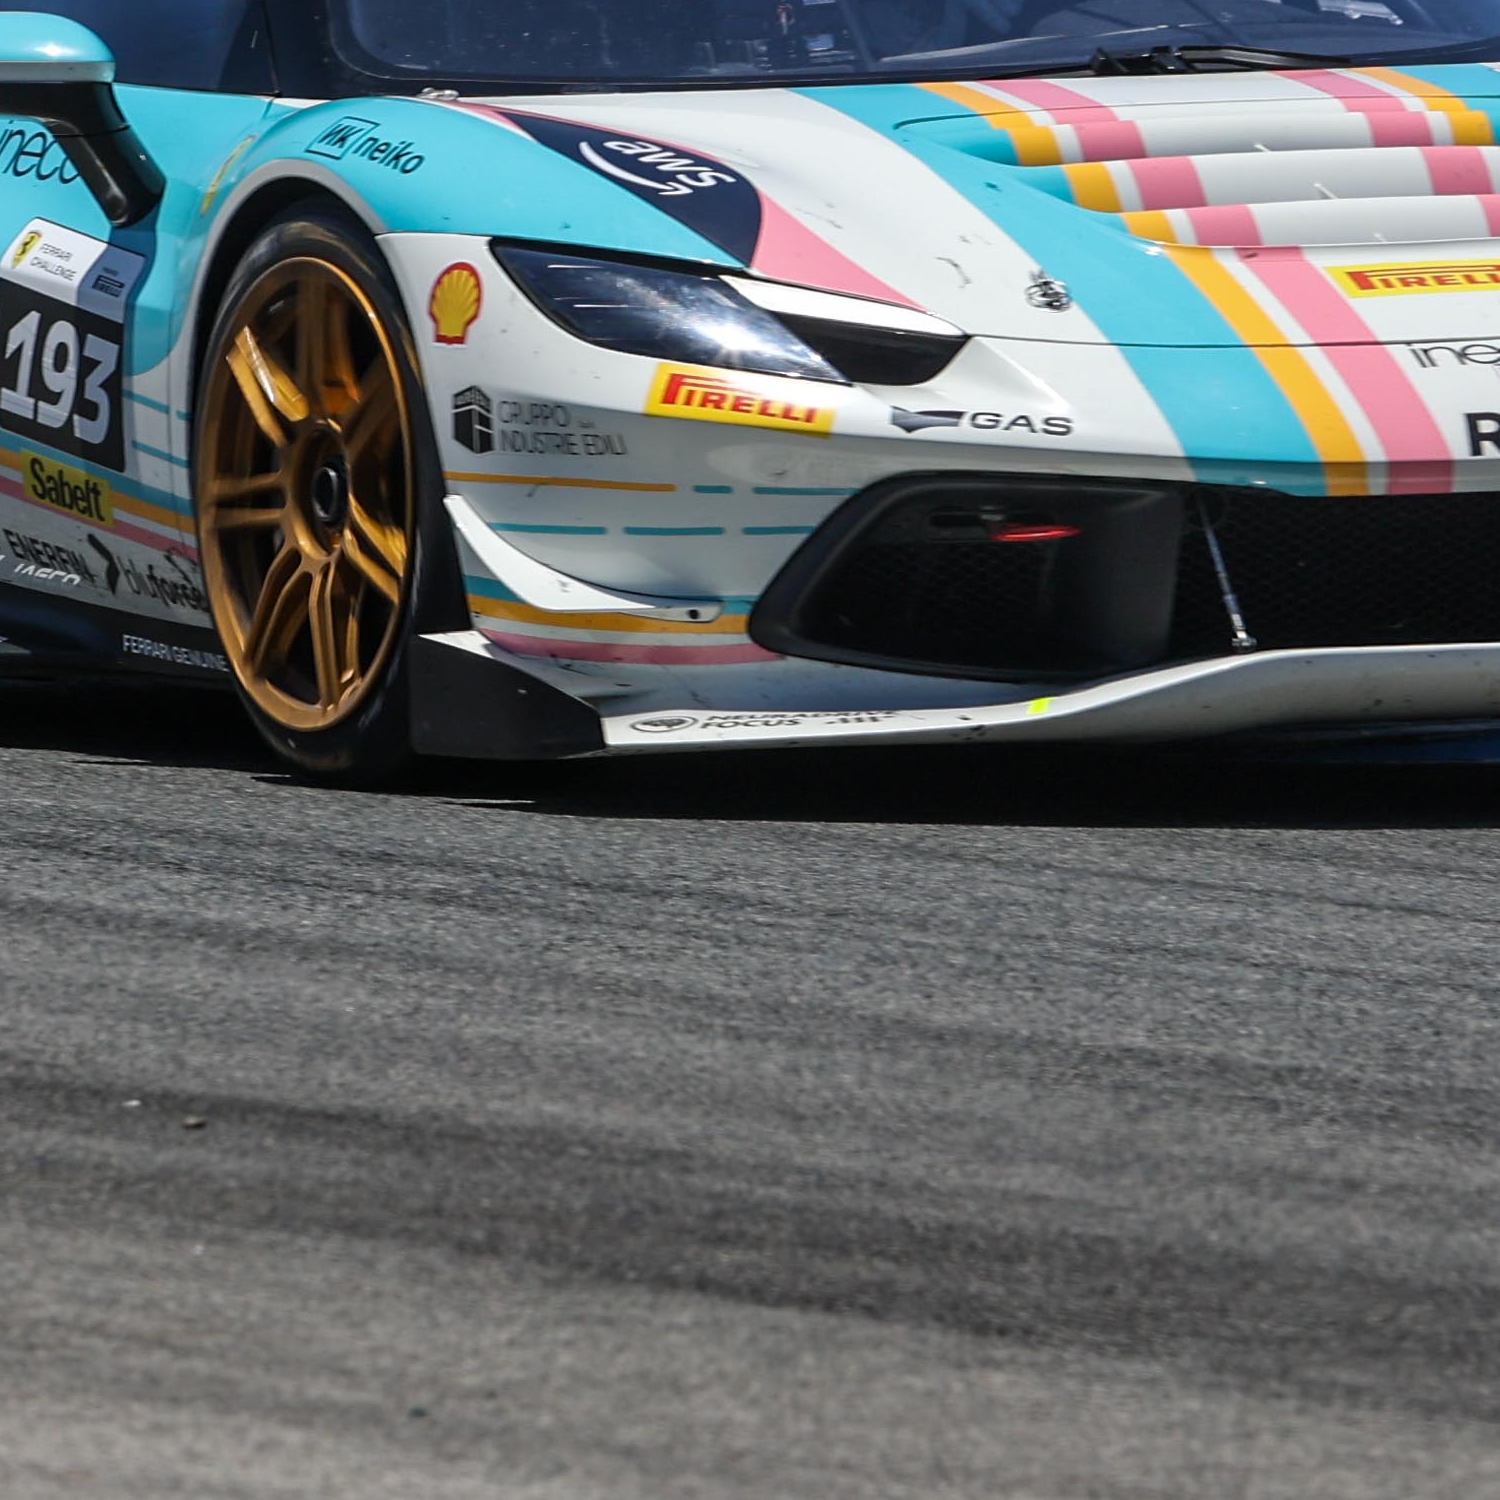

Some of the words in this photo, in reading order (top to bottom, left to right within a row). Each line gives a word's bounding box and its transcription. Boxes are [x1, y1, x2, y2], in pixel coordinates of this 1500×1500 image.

[352, 136, 425, 174] neiko
[602, 141, 737, 187] aws
[30, 256, 77, 282] CHALLENGE
[39, 243, 74, 262] FERRARI
[0, 310, 120, 444] 193
[662, 373, 818, 424] PIRELLI
[967, 412, 1074, 436] GAS
[29, 457, 106, 522] Sabelt
[122, 633, 173, 661] FERRARI
[700, 718, 802, 729] FOCUS
